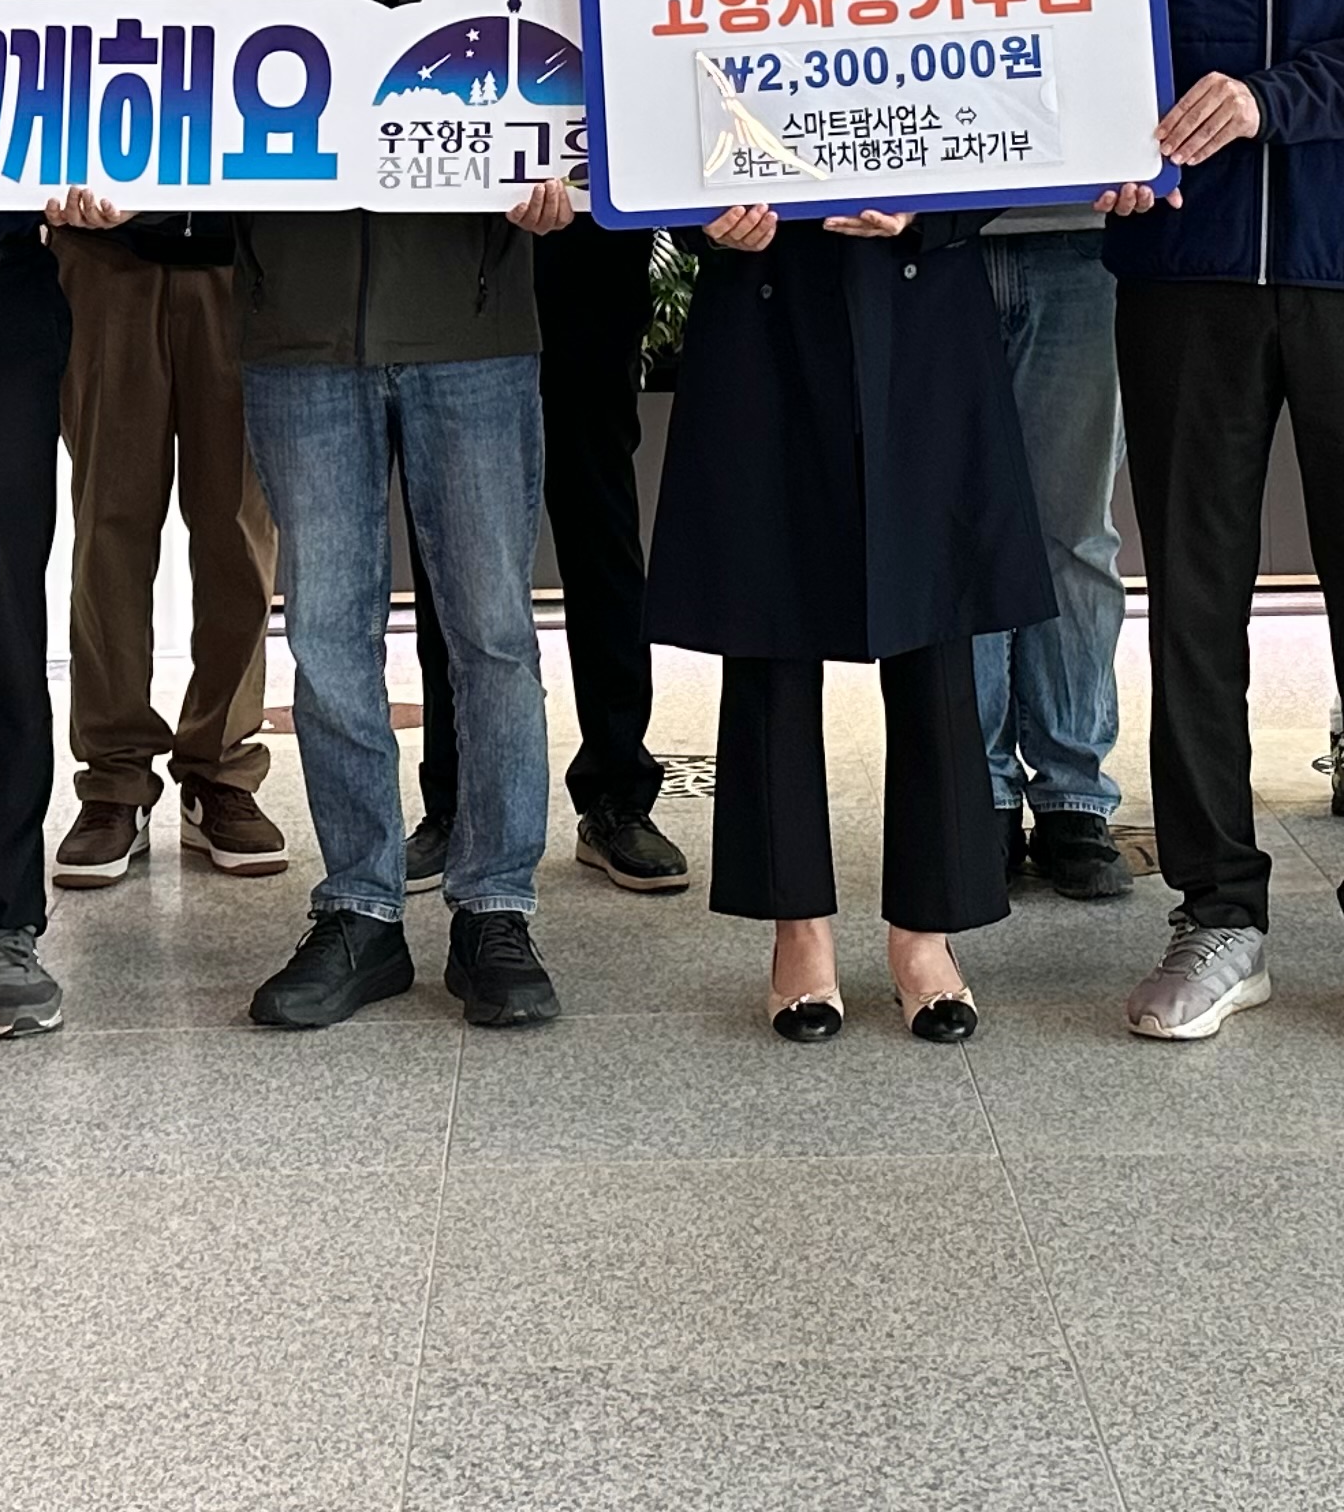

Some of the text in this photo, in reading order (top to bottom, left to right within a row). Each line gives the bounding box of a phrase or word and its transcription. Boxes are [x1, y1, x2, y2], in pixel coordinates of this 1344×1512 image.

[378, 120, 494, 154] 우주항공
[782, 103, 943, 141] 스마트팜사업소
[813, 138, 929, 173] 자치행정과
[940, 129, 1034, 164] 교차기부
[377, 156, 490, 189] 중심도시
